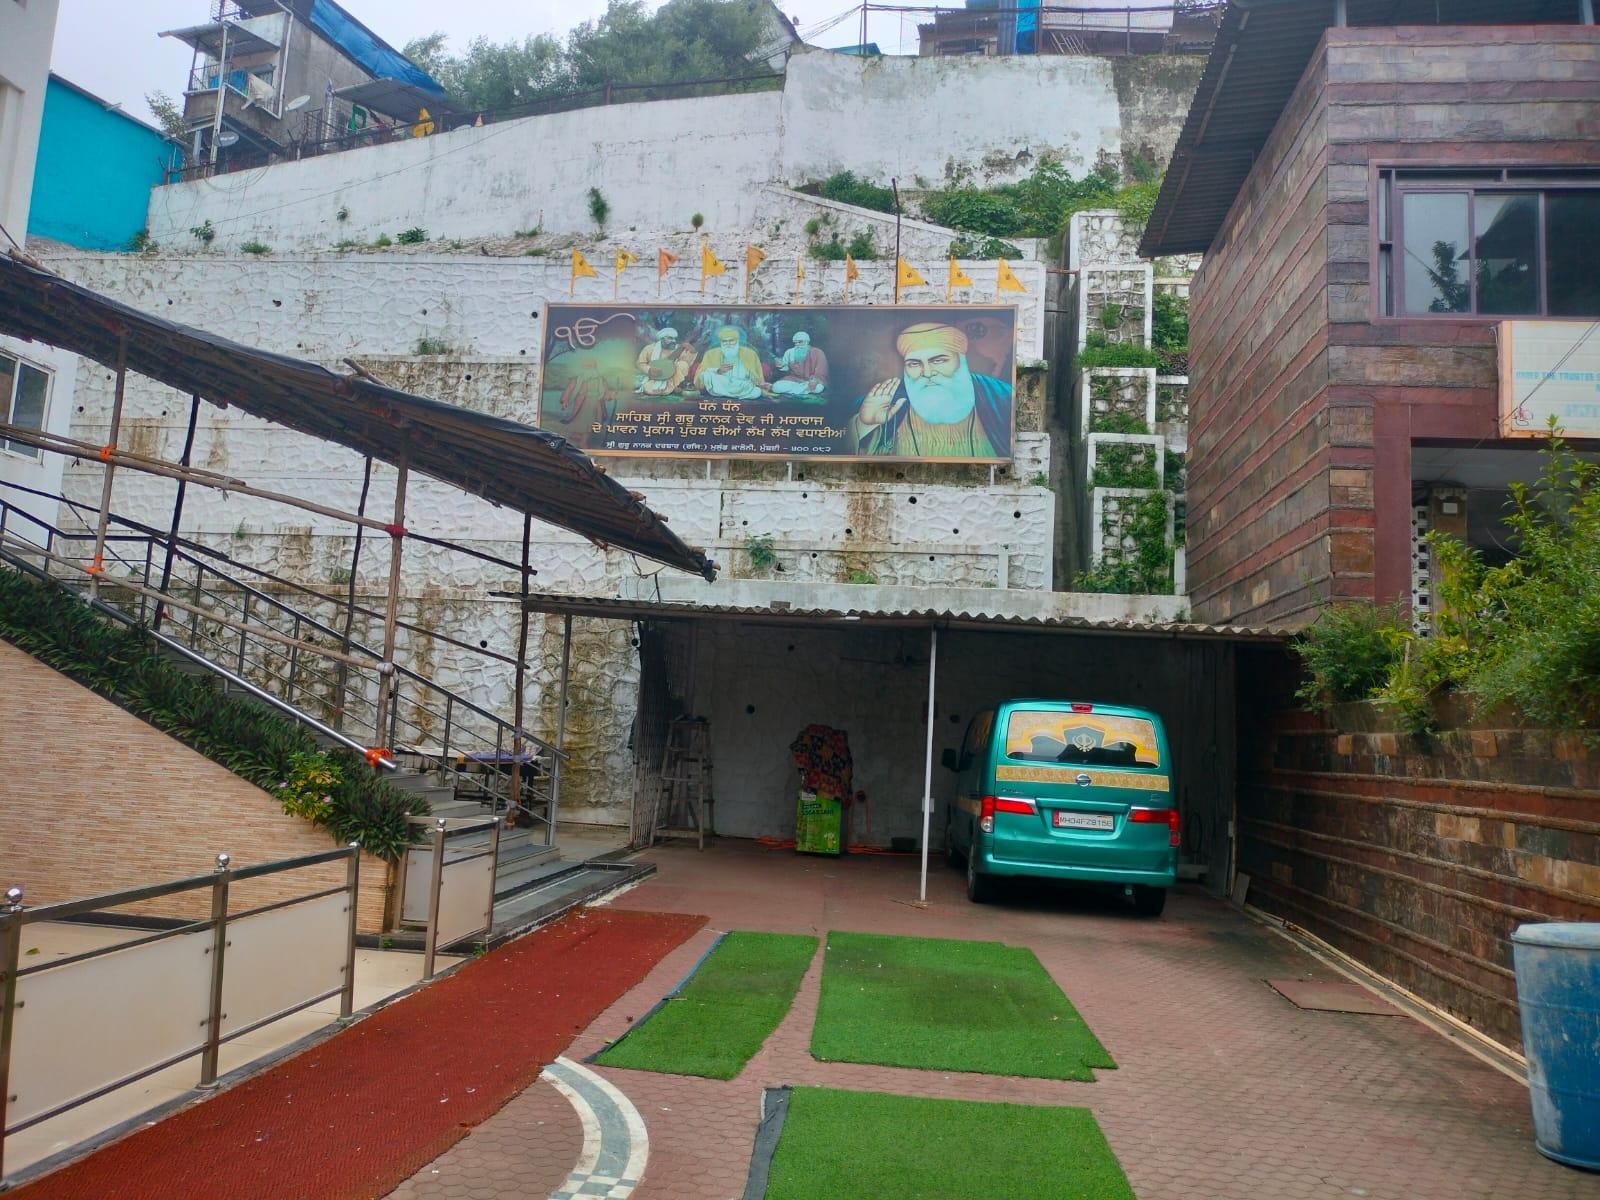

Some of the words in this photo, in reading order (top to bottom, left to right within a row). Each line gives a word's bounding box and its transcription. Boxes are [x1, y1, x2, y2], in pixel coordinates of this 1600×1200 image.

[698, 400, 717, 411] ਧੰਨ
[722, 400, 741, 412] ਧੰਨ
[616, 410, 652, 423] ਸਾਹਿਬ
[675, 414, 695, 427] ਗੁਰੂ
[699, 415, 731, 424] ਨਾਨਕ
[736, 412, 755, 425] ਦੇਵ
[760, 413, 774, 425] ਜੀ
[779, 416, 824, 425] ਮਹਾਰਾਜ
[592, 422, 602, 433] ਦੇ
[607, 424, 638, 434] ਪਾਵਨ
[680, 426, 708, 438] ਪੁਰਬ
[712, 425, 741, 437] ਦੀਆਂ
[746, 425, 766, 437] ਲੱਖ
[771, 426, 791, 437] ਲੱਖ
